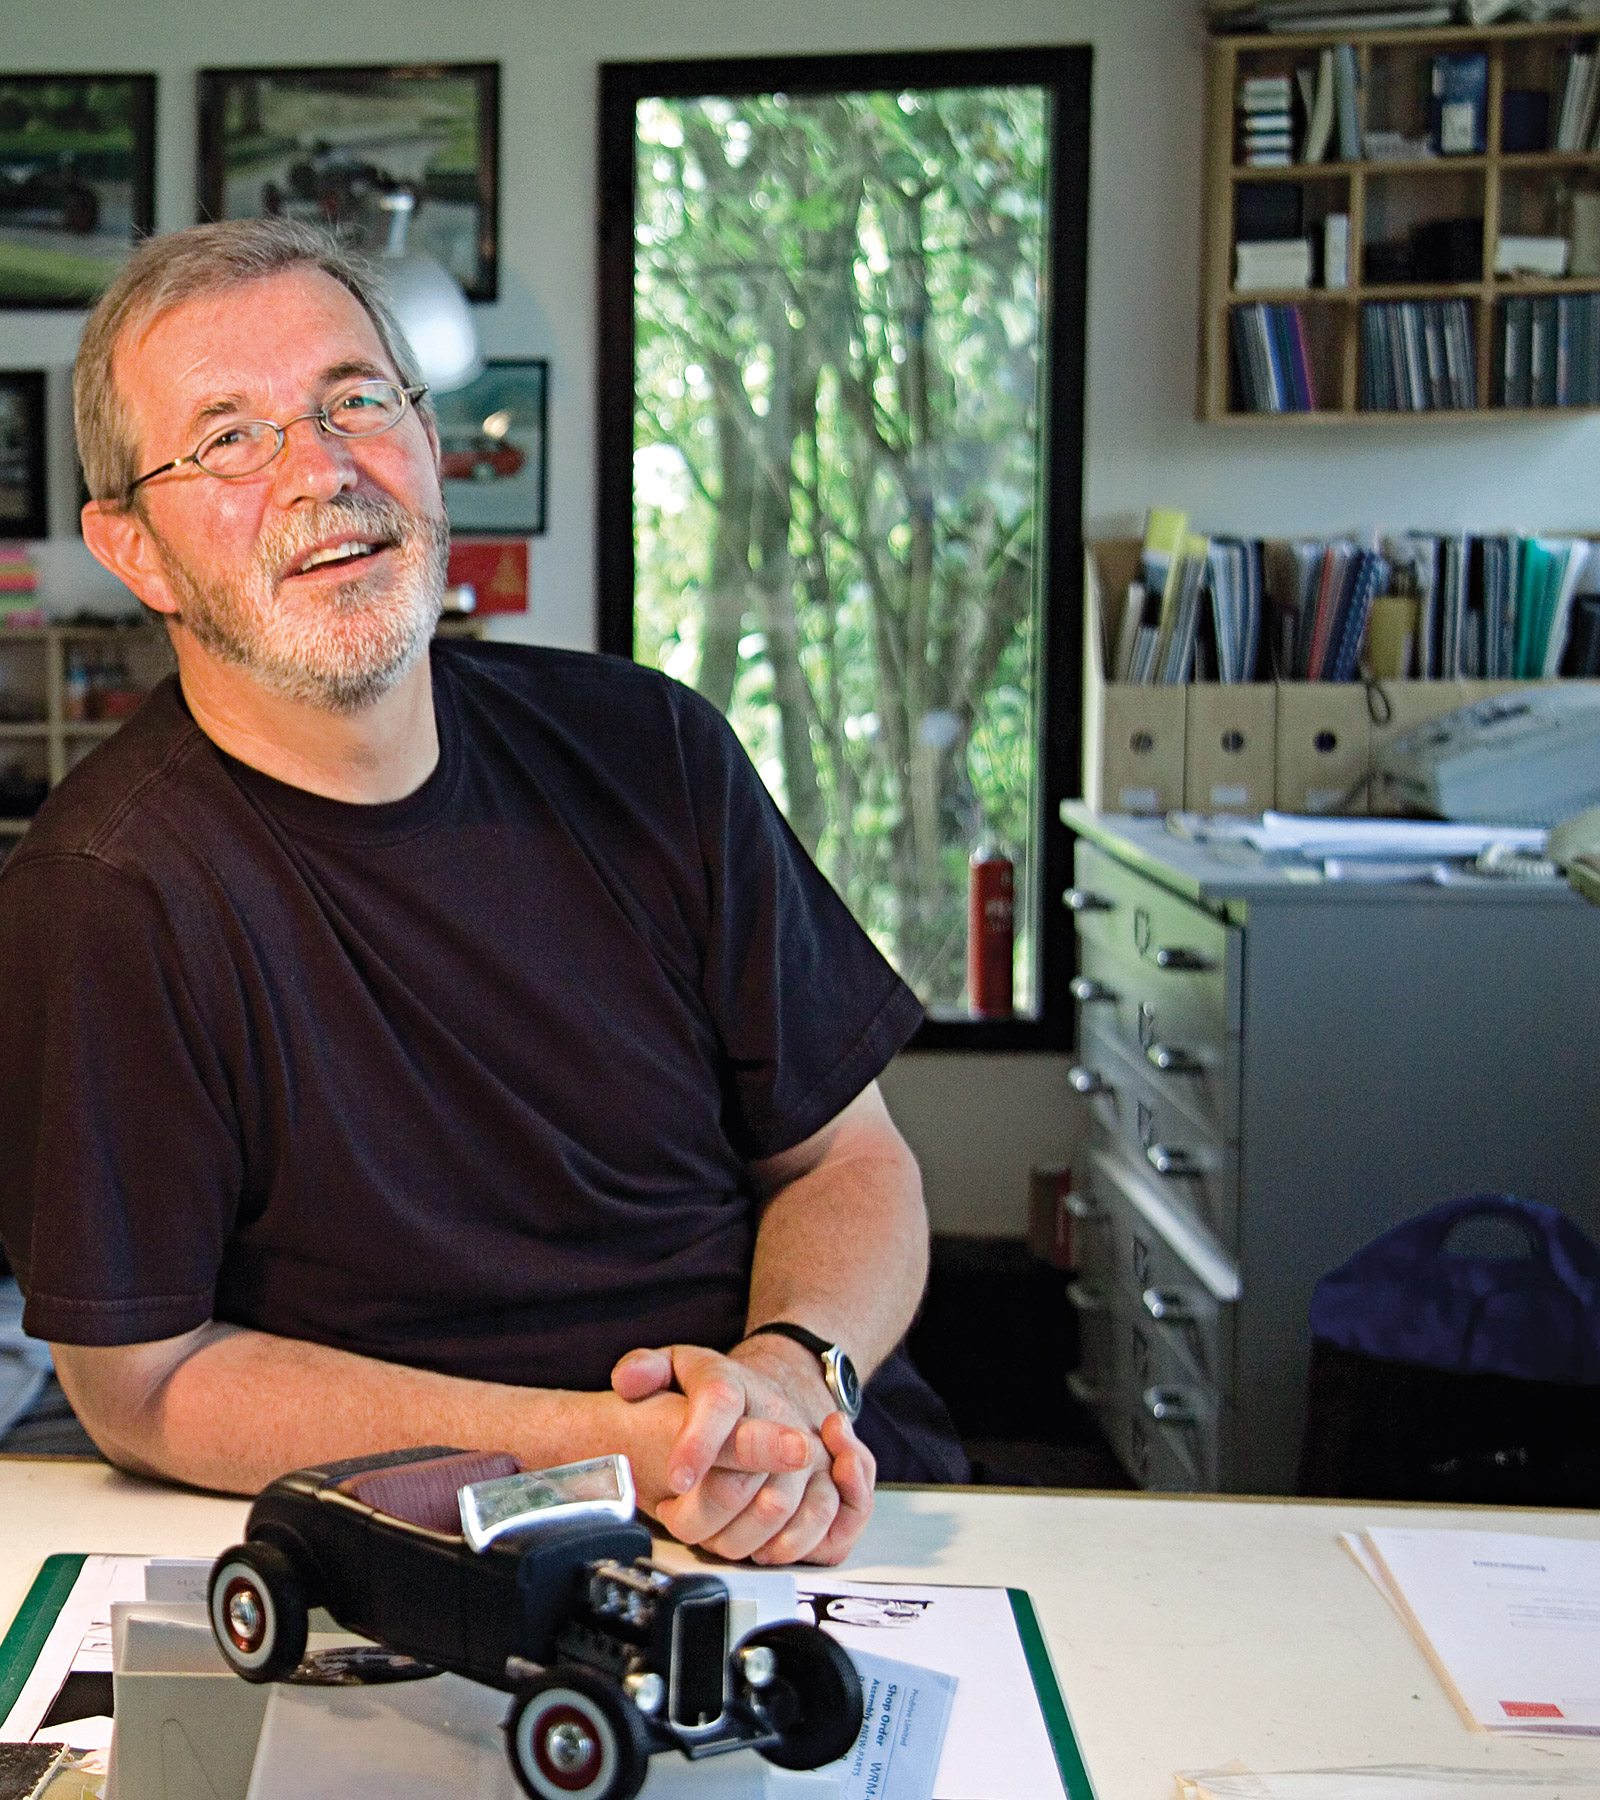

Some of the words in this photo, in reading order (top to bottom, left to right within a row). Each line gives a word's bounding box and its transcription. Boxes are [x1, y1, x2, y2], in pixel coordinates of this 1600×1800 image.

[863, 1678, 880, 1721] Assembly
[882, 1683, 897, 1712] Shop
[876, 1714, 890, 1747] Order
[864, 1762, 882, 1800] WRM-
